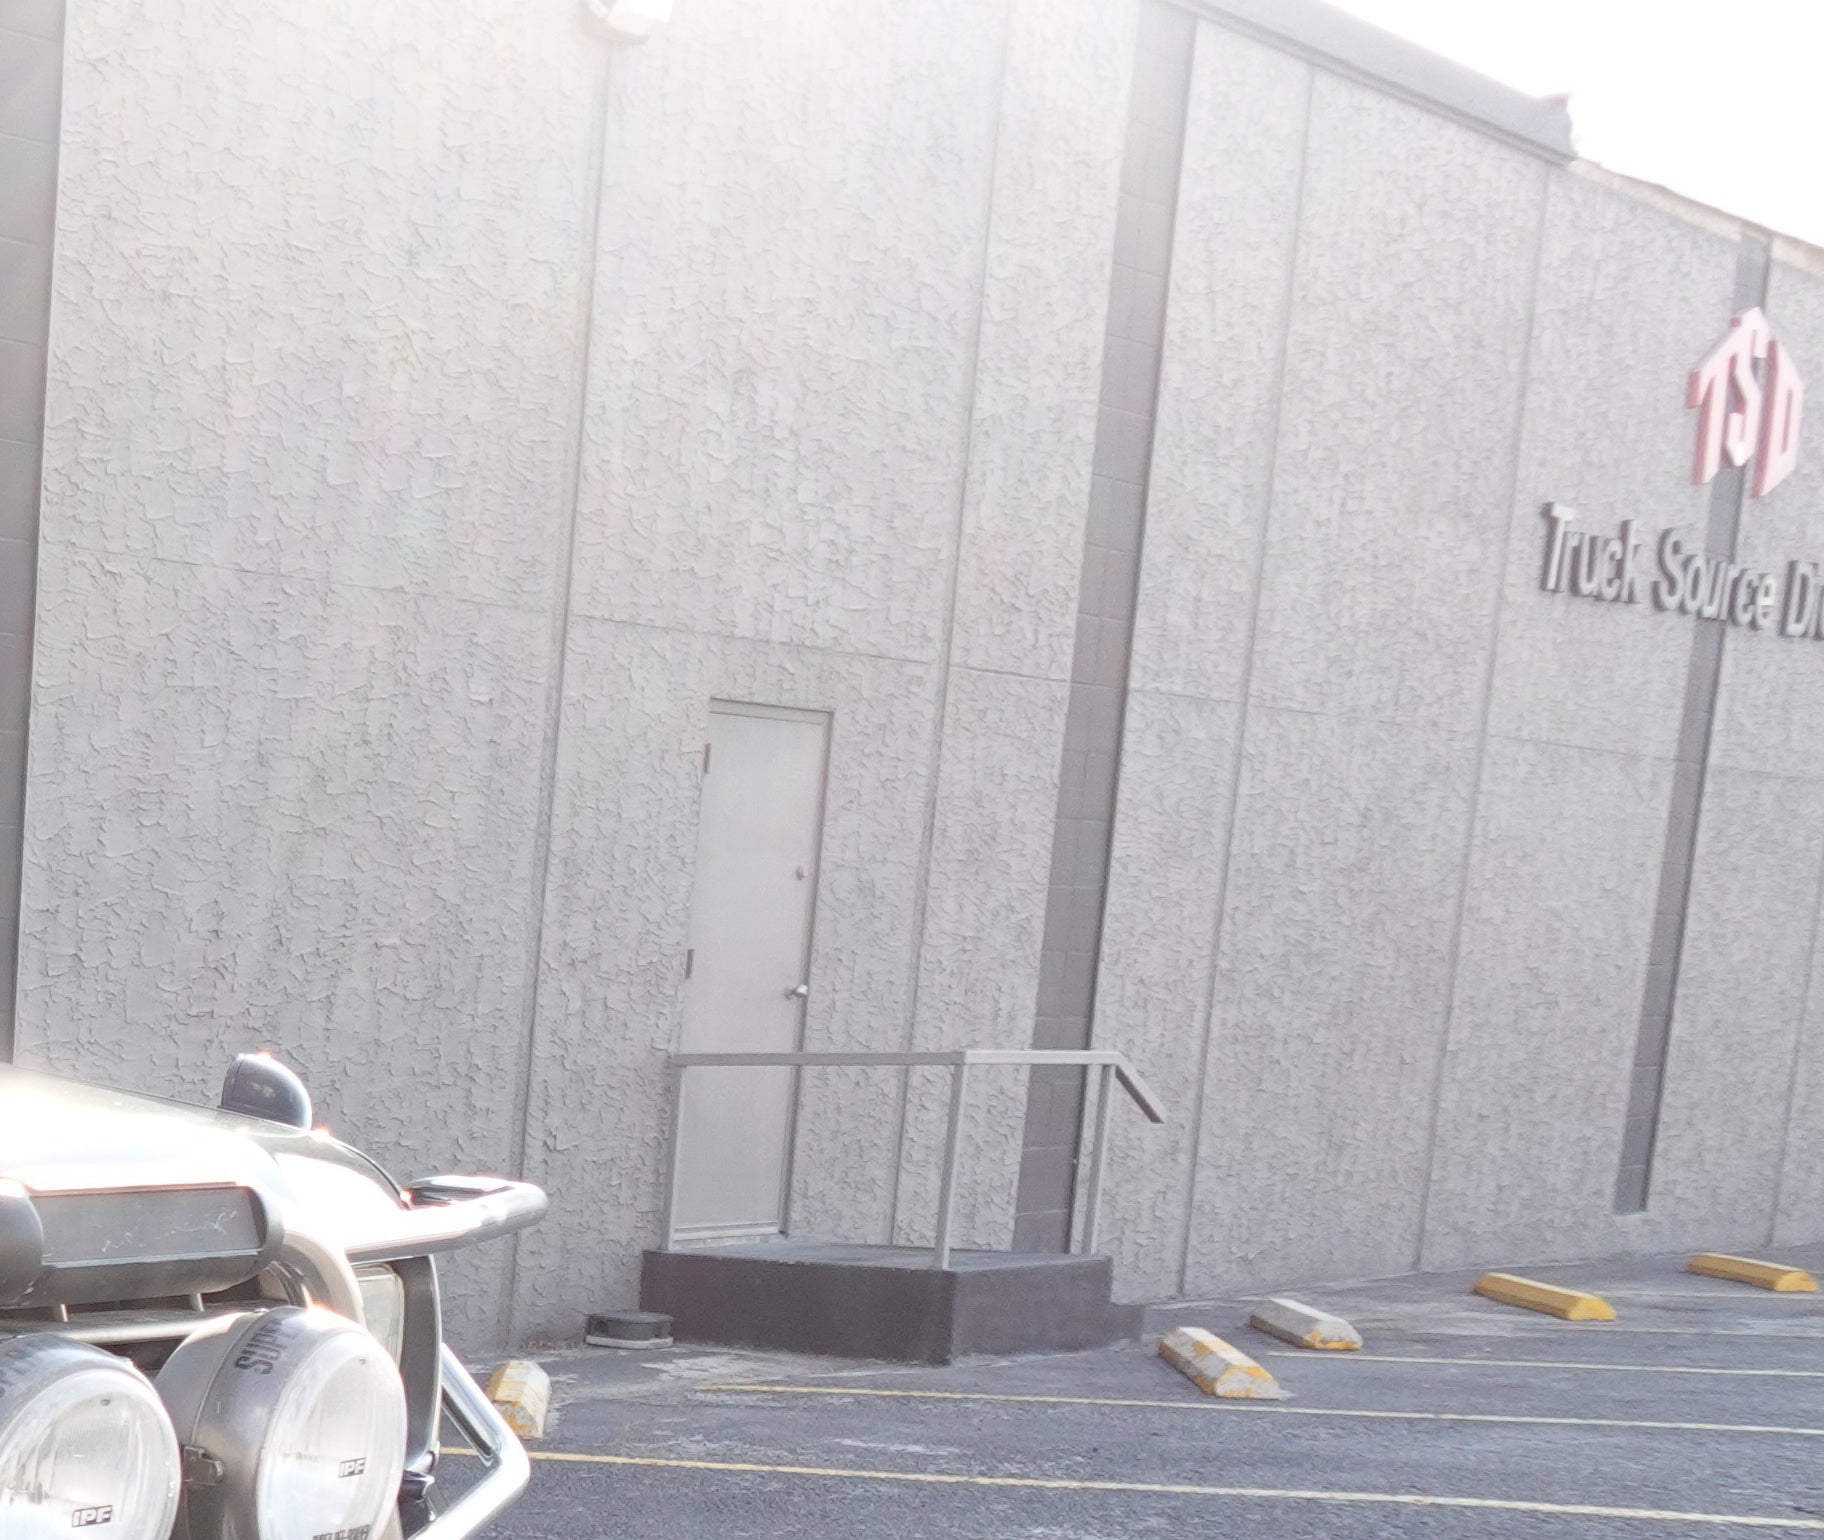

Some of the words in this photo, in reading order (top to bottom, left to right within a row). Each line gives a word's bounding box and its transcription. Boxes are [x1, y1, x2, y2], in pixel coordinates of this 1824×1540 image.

[1687, 306, 1803, 497] TSD
[1540, 501, 1642, 603] Truck
[1652, 527, 1776, 631] Source
[1779, 560, 1824, 640] Di
[338, 1457, 367, 1478] IPF
[72, 1504, 114, 1528] IPF
